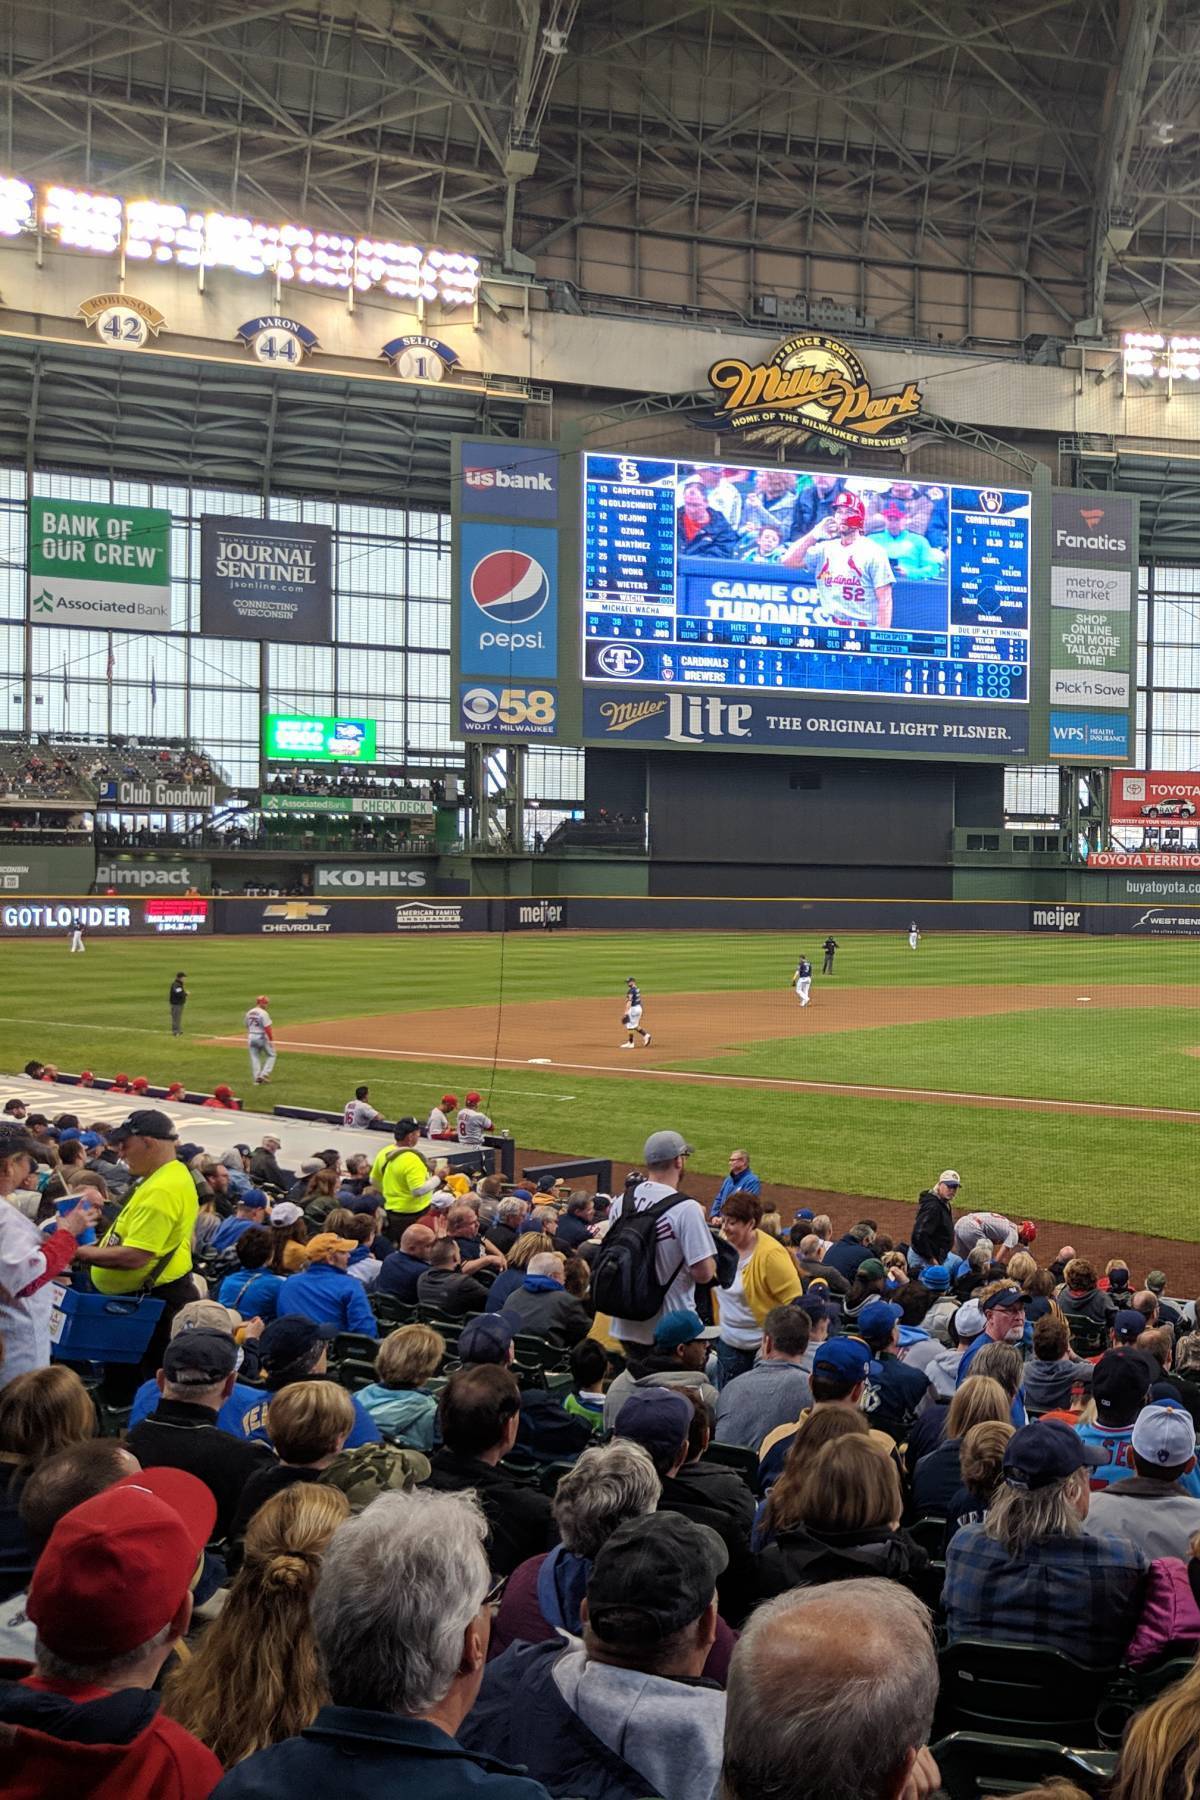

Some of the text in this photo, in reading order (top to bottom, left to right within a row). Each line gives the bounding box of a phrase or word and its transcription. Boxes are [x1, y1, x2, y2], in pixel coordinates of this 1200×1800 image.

[90, 295, 154, 317] ROBINSON
[102, 315, 144, 343] 42
[258, 318, 299, 332] AARON
[260, 339, 296, 361] 44
[403, 336, 438, 350] SELIG
[784, 338, 850, 358] SINCE 2001
[416, 357, 428, 378] 1
[710, 359, 844, 409] Miller
[819, 379, 921, 424] Park
[732, 412, 908, 446] HOME OF THE MILWAUKEE BREWERS
[612, 487, 654, 497] CARPENTER
[608, 500, 657, 510] GOLDSCHMIDT
[619, 514, 647, 522] DEJONG
[43, 511, 134, 540] BANK OF
[621, 527, 645, 536] OZUNA
[1056, 530, 1126, 551] Fanatics
[43, 538, 87, 562] OUR
[216, 543, 316, 566] JOURNAL
[618, 554, 647, 563] FOWLER
[216, 562, 316, 584] SENTINEL
[622, 567, 643, 576] WONG
[230, 581, 304, 592] jsonline.com
[617, 580, 648, 590] WIETERS
[1066, 576, 1104, 589] metro
[711, 581, 788, 602] GAME
[842, 586, 866, 602] 52
[1066, 588, 1110, 601] market
[233, 599, 298, 611] CONNECTING
[602, 604, 660, 614] MICHAEL WACHA
[238, 608, 293, 619] WISCONSIN
[1076, 613, 1107, 625] SHOP
[982, 628, 998, 636] NEXT
[1070, 624, 1112, 636] ONLINE
[480, 631, 543, 651] pepsi
[1062, 634, 1120, 647] FOR MORE
[1066, 643, 1117, 657] TAILGATE
[681, 655, 729, 668] CARDINALS
[1076, 655, 1106, 667] TIME!
[684, 671, 726, 682] BREWERS
[1094, 683, 1126, 696] Save
[498, 689, 556, 724] 58
[600, 693, 752, 743] Miller Lite
[465, 722, 554, 733] WDJT MILWAUKEE
[766, 716, 1011, 740] THE ORIGINAL LIGHT PILSNER.
[1053, 725, 1127, 744] WPS HEALTH INSURANCE
[120, 783, 216, 806] Club Goodwill
[362, 800, 427, 813] CHECK DECK
[1090, 853, 1145, 867] TOYOTA
[110, 863, 190, 887] impact
[319, 870, 427, 887] KOHL'S
[519, 902, 562, 925] meijer
[1033, 907, 1081, 929] meijer
[262, 924, 331, 932] CHEVROLET
[1150, 918, 1177, 926] WEST
